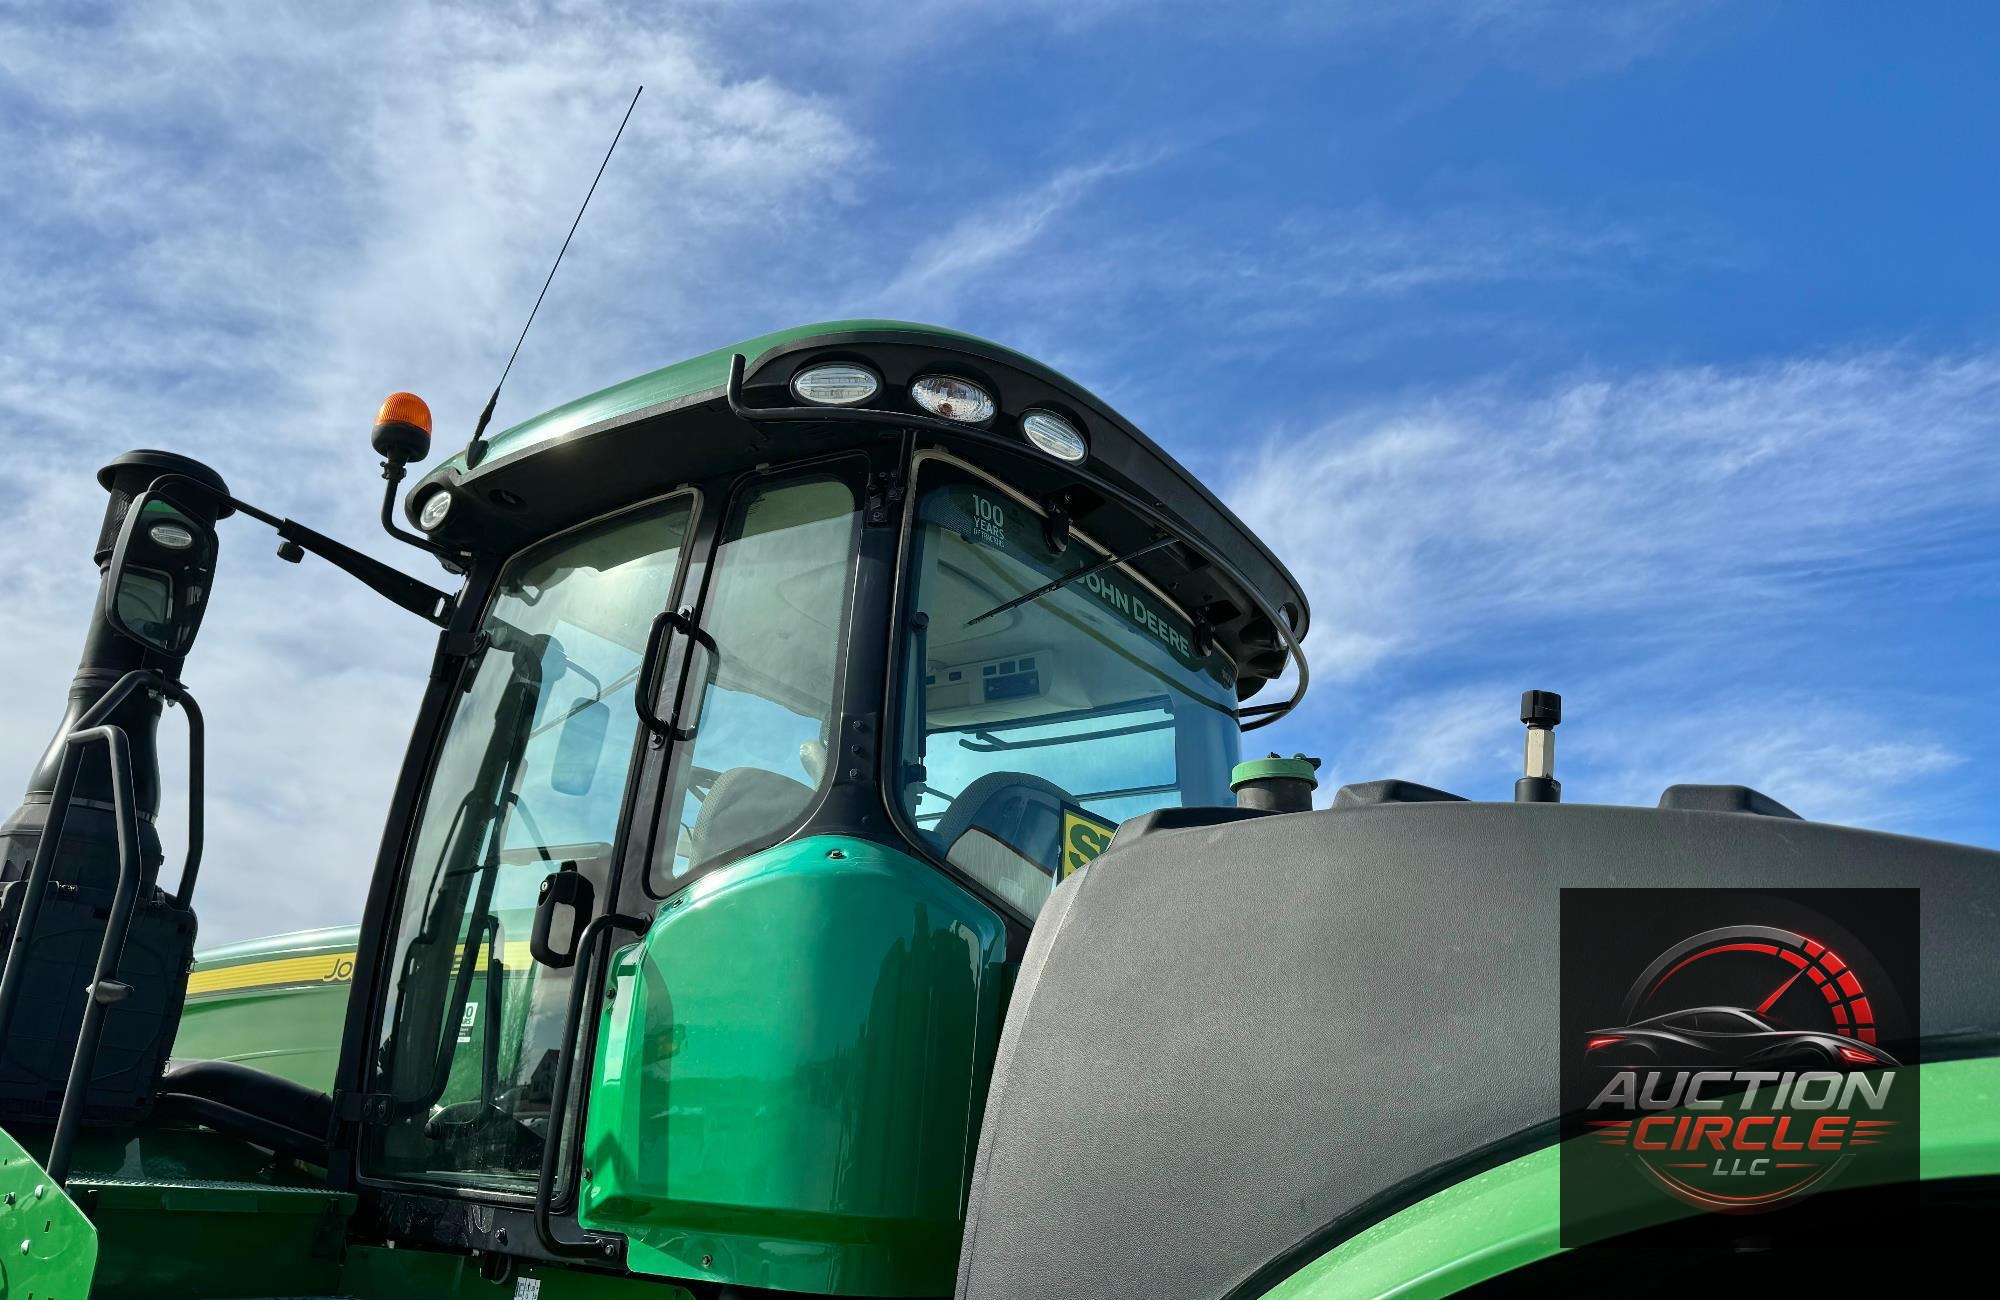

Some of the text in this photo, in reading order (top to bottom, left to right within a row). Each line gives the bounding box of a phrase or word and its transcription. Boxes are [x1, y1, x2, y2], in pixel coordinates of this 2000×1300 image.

[973, 494, 1004, 527] 100
[974, 516, 1005, 540] YEARS
[1132, 595, 1190, 658] DEERE
[324, 957, 354, 979] JO
